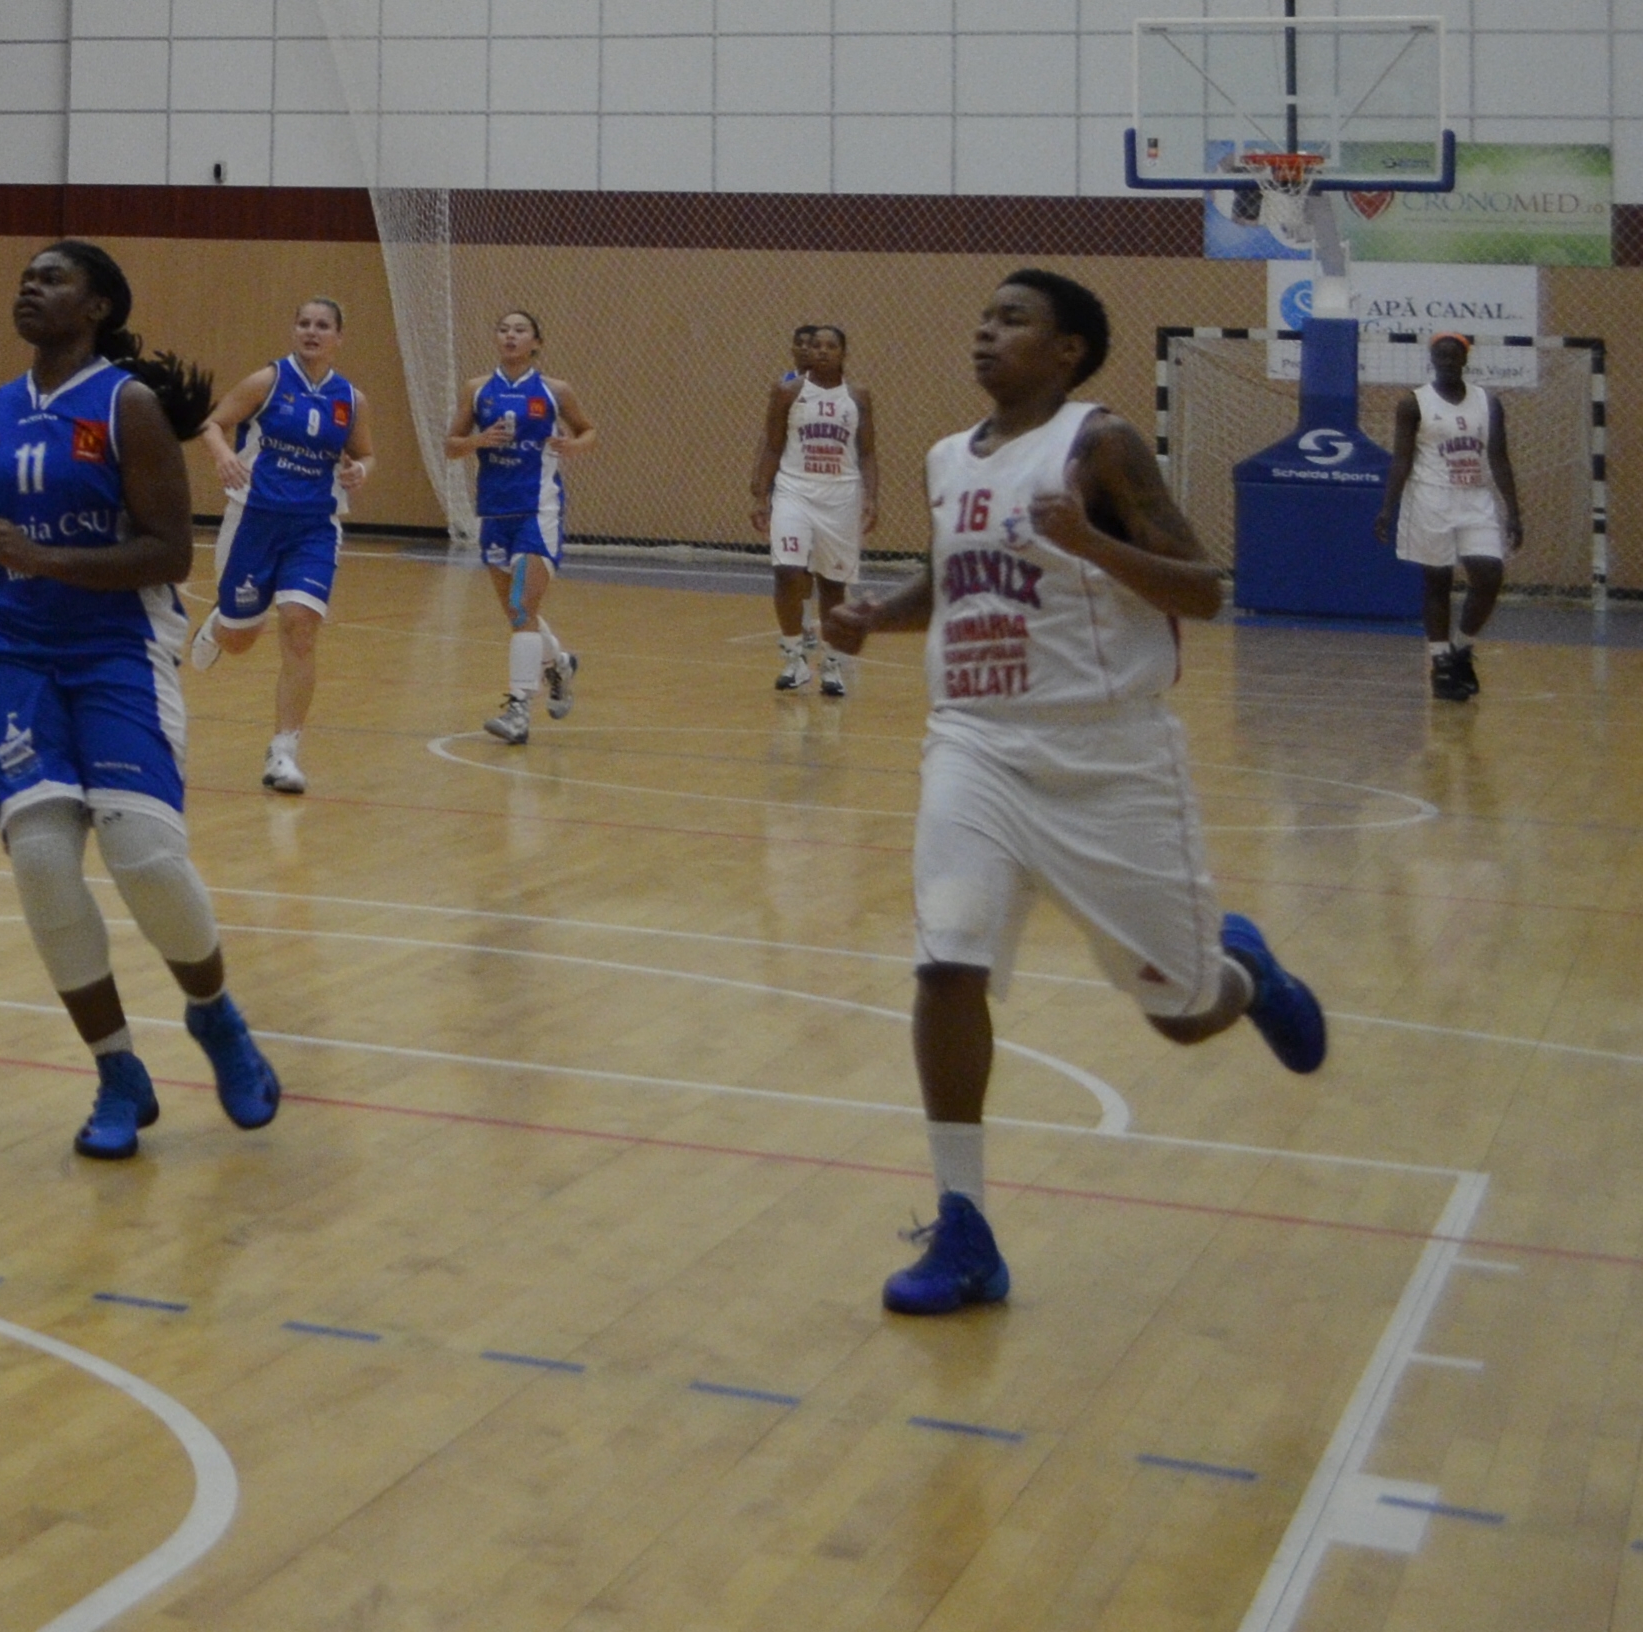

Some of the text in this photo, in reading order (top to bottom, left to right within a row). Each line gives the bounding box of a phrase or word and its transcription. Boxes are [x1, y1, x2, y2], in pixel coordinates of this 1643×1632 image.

[1367, 296, 1510, 320] APĂ CANAL
[818, 401, 835, 418] 13
[14, 441, 47, 495] 11
[1272, 467, 1381, 482] Schelde Sports
[59, 509, 111, 537] CSU
[955, 488, 992, 534] 16
[781, 536, 799, 552] 13
